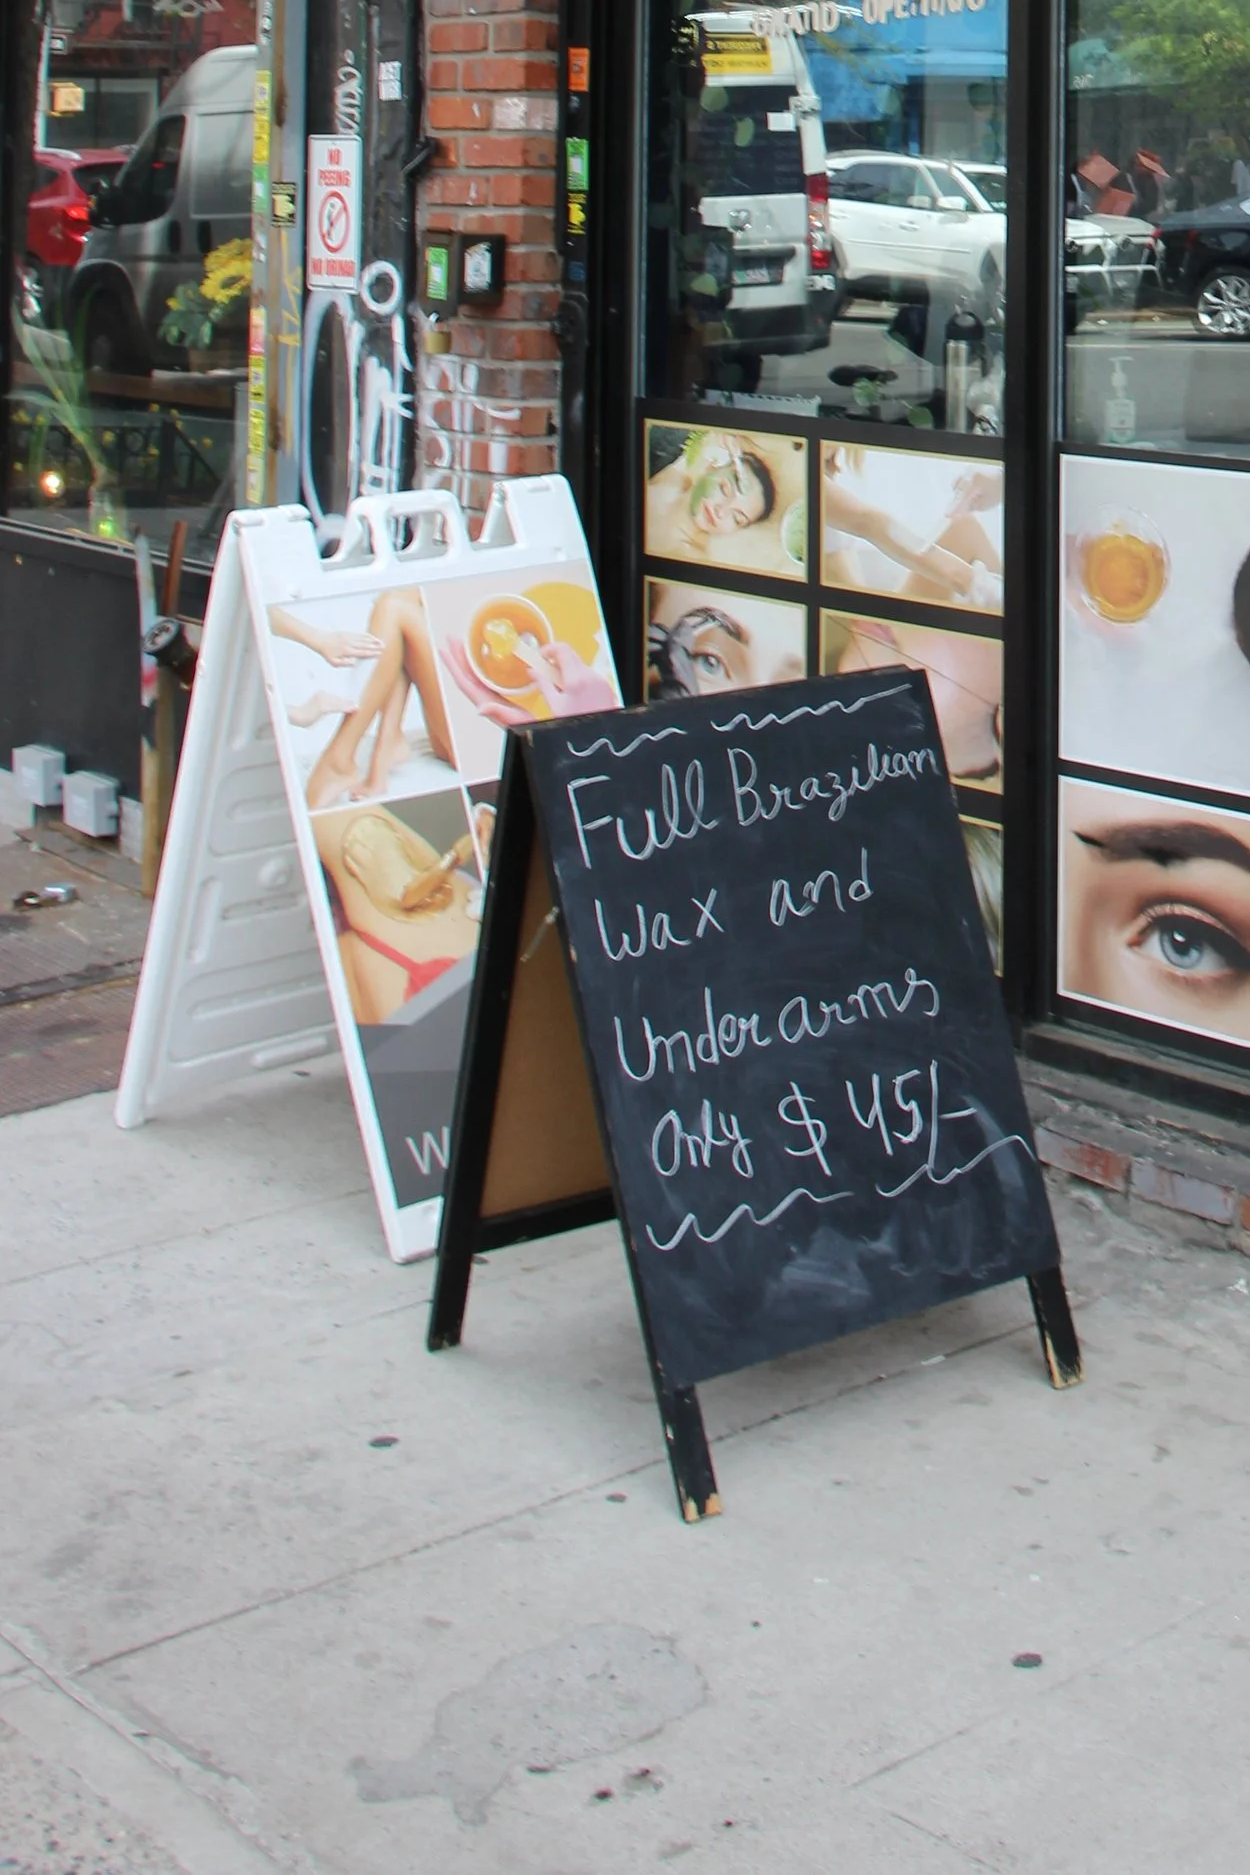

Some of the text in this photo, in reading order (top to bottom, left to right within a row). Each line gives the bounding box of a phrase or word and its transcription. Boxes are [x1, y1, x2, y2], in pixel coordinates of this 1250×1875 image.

[327, 148, 342, 166] NO
[566, 742, 941, 870] Full Brazilian
[594, 846, 874, 962] Wax and
[651, 1097, 754, 1178] Only
